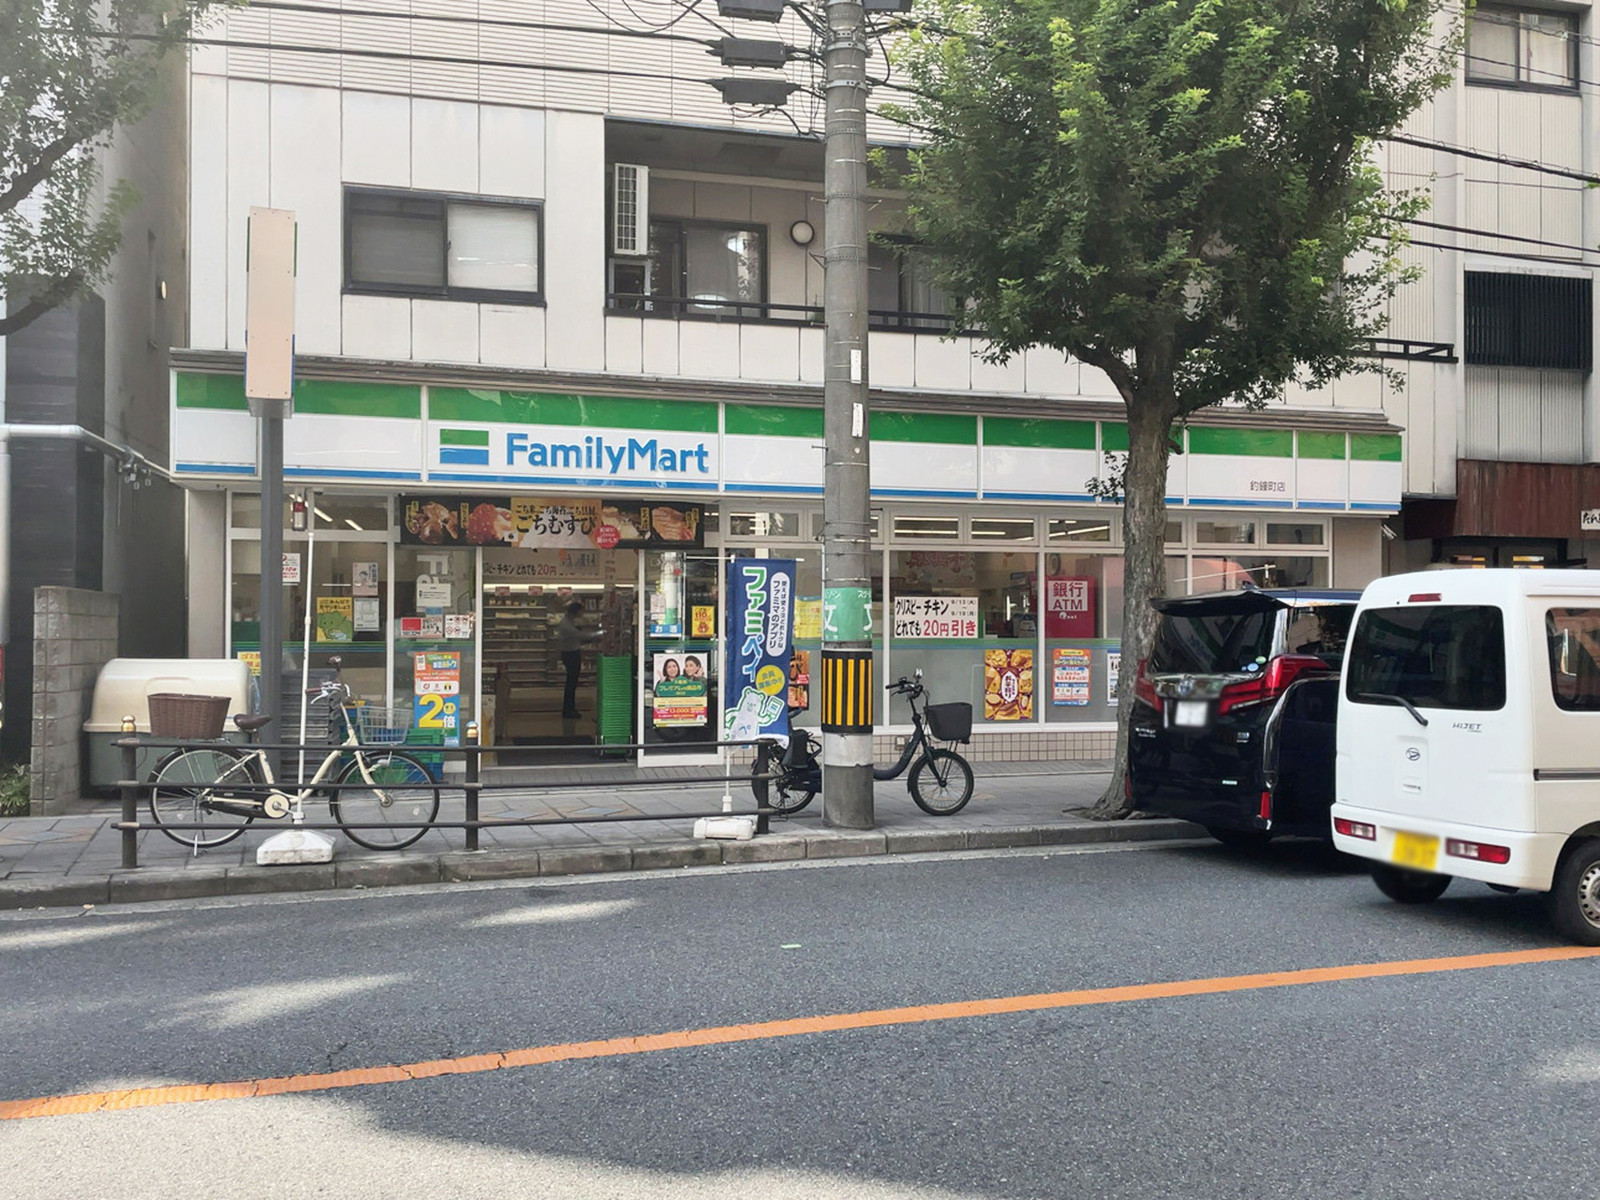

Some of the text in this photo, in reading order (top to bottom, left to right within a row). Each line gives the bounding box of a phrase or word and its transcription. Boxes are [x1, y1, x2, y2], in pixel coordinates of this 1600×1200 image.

[506, 432, 709, 474] FamilyMart
[516, 515, 597, 536] ごちむすび
[1053, 582, 1083, 597] 銀行
[1053, 599, 1083, 610] ATM
[769, 580, 780, 649] ファミマのアプリ
[742, 566, 768, 683] ファミペイ
[896, 620, 921, 636] どれでも
[1453, 722, 1482, 730] HIJET
